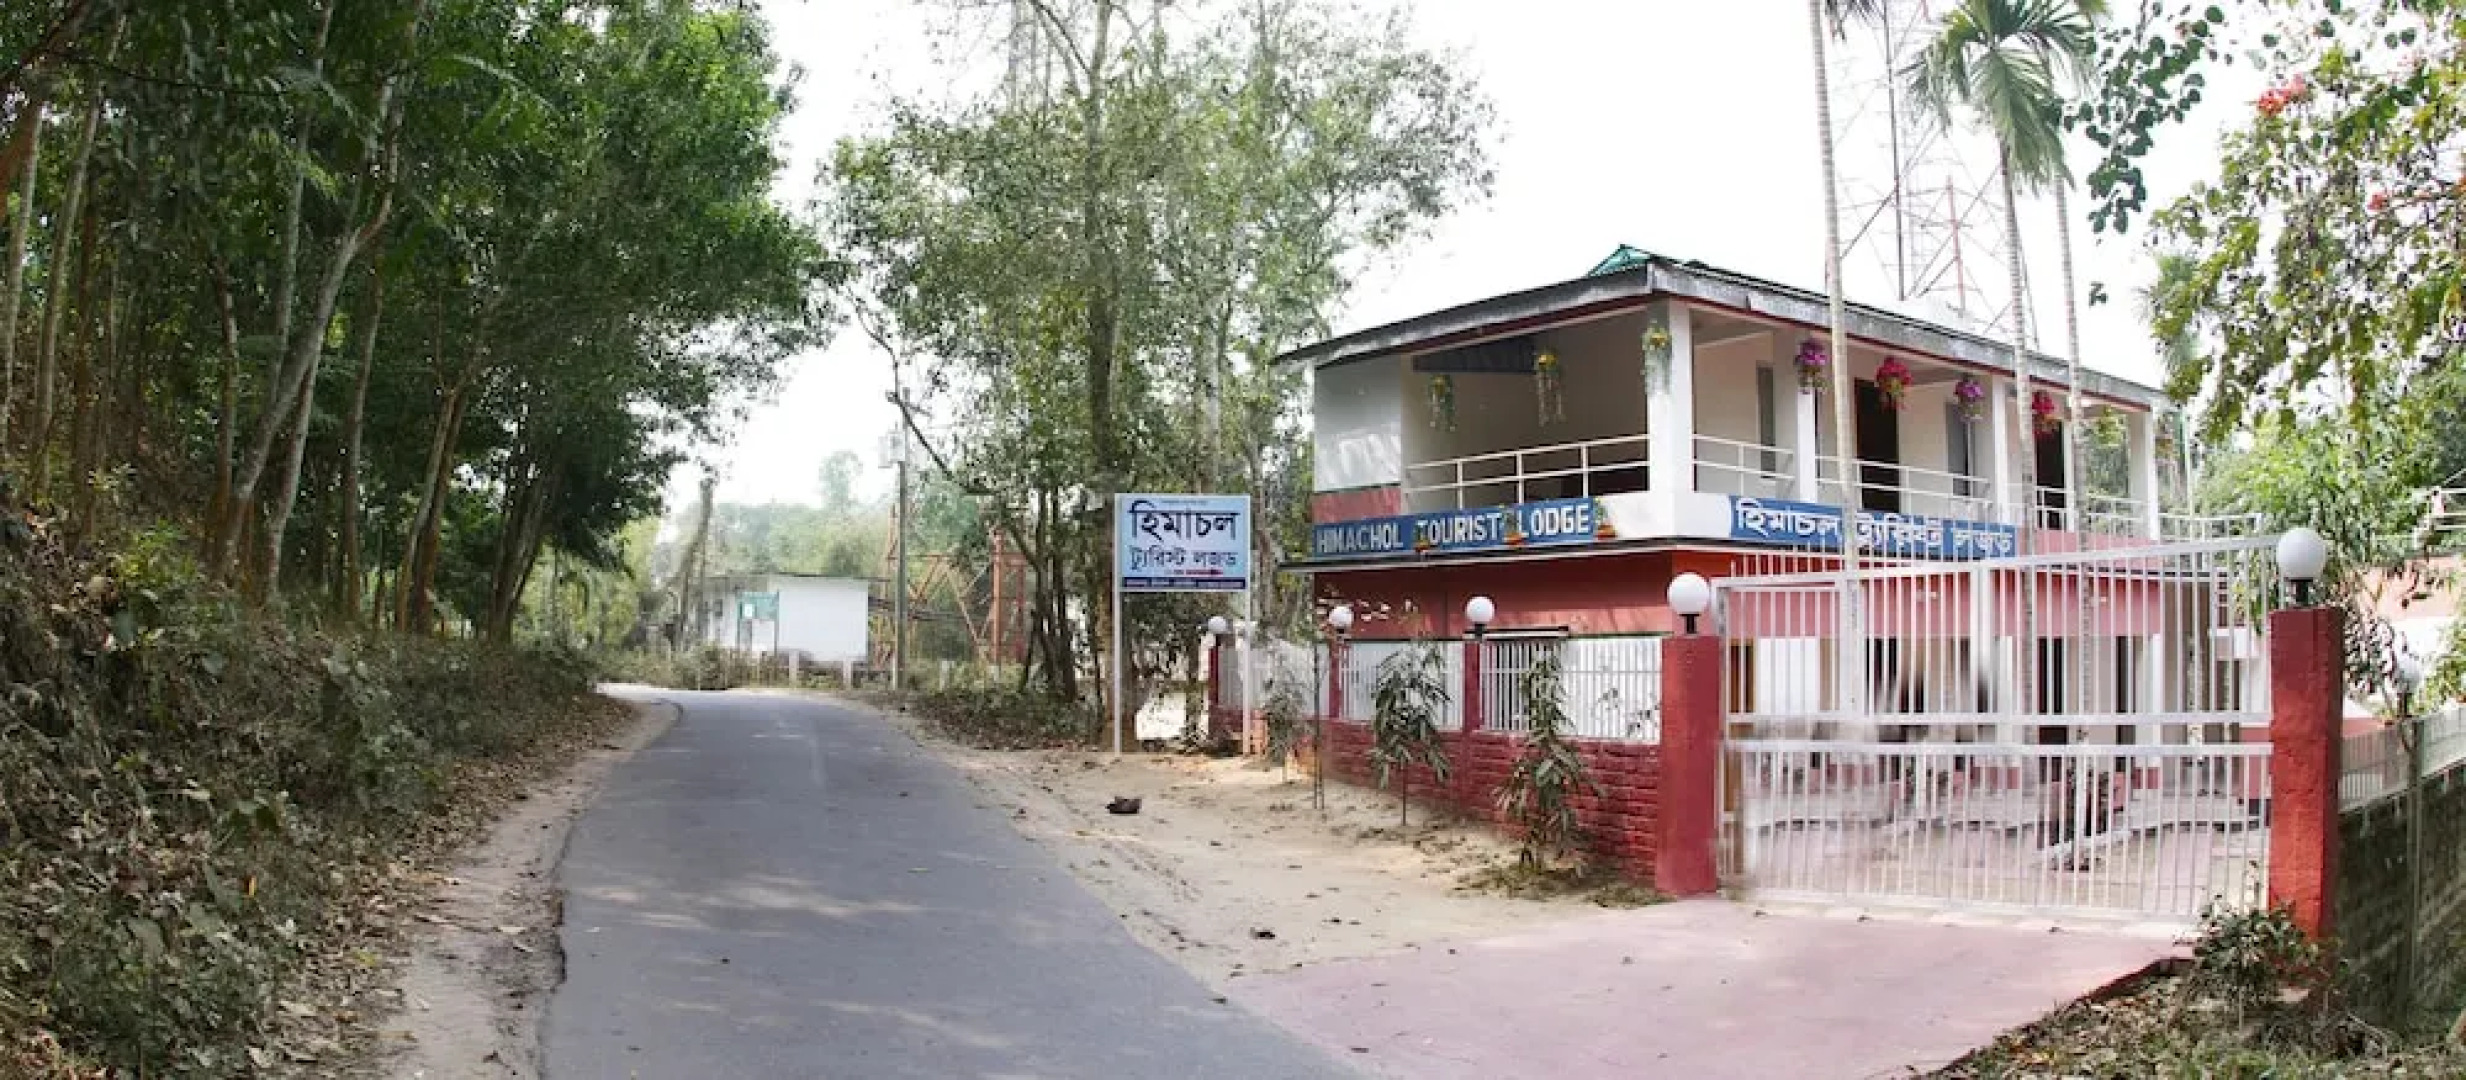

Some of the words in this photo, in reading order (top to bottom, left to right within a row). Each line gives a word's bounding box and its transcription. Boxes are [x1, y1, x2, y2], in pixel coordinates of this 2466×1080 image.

[1128, 500, 1241, 542] হিমাচল
[1317, 522, 1404, 553] HIMACHOL
[1518, 503, 1590, 537] LODGE
